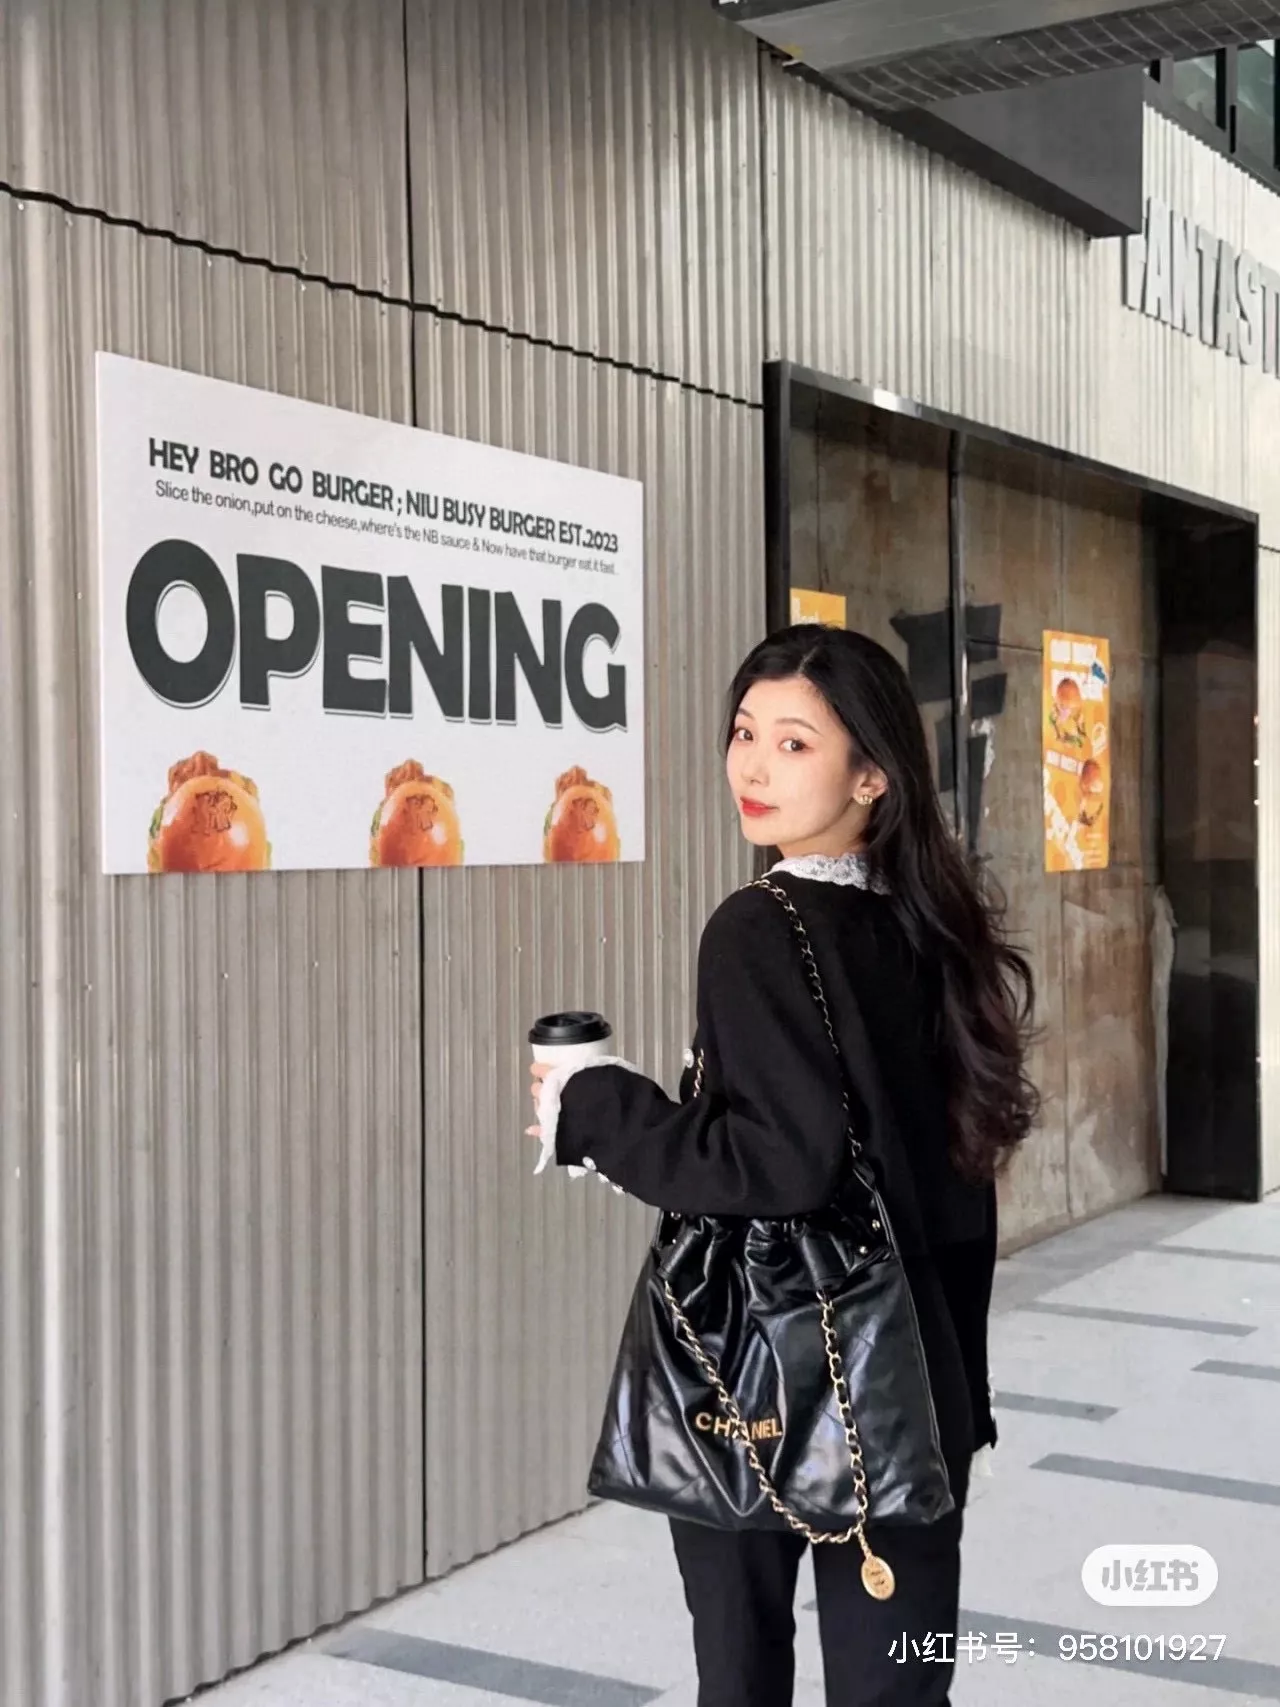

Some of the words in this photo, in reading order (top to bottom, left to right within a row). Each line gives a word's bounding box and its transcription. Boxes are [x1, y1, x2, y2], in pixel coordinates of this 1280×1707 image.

[149, 437, 199, 474] HEY
[209, 449, 259, 486] BRO
[269, 462, 303, 494] GO
[312, 470, 394, 511] BURGER
[406, 489, 438, 520] NIU
[443, 497, 486, 528] BUSY
[489, 506, 555, 542] BURGER
[155, 479, 189, 501] Slice
[191, 486, 213, 506] the
[276, 503, 292, 520] on
[294, 504, 314, 523] the
[404, 525, 422, 542] the
[422, 527, 439, 545] NB
[440, 534, 471, 552] sauce
[472, 536, 480, 552] &
[481, 538, 504, 556] Now
[504, 543, 527, 561] have
[126, 538, 628, 733] OPENING
